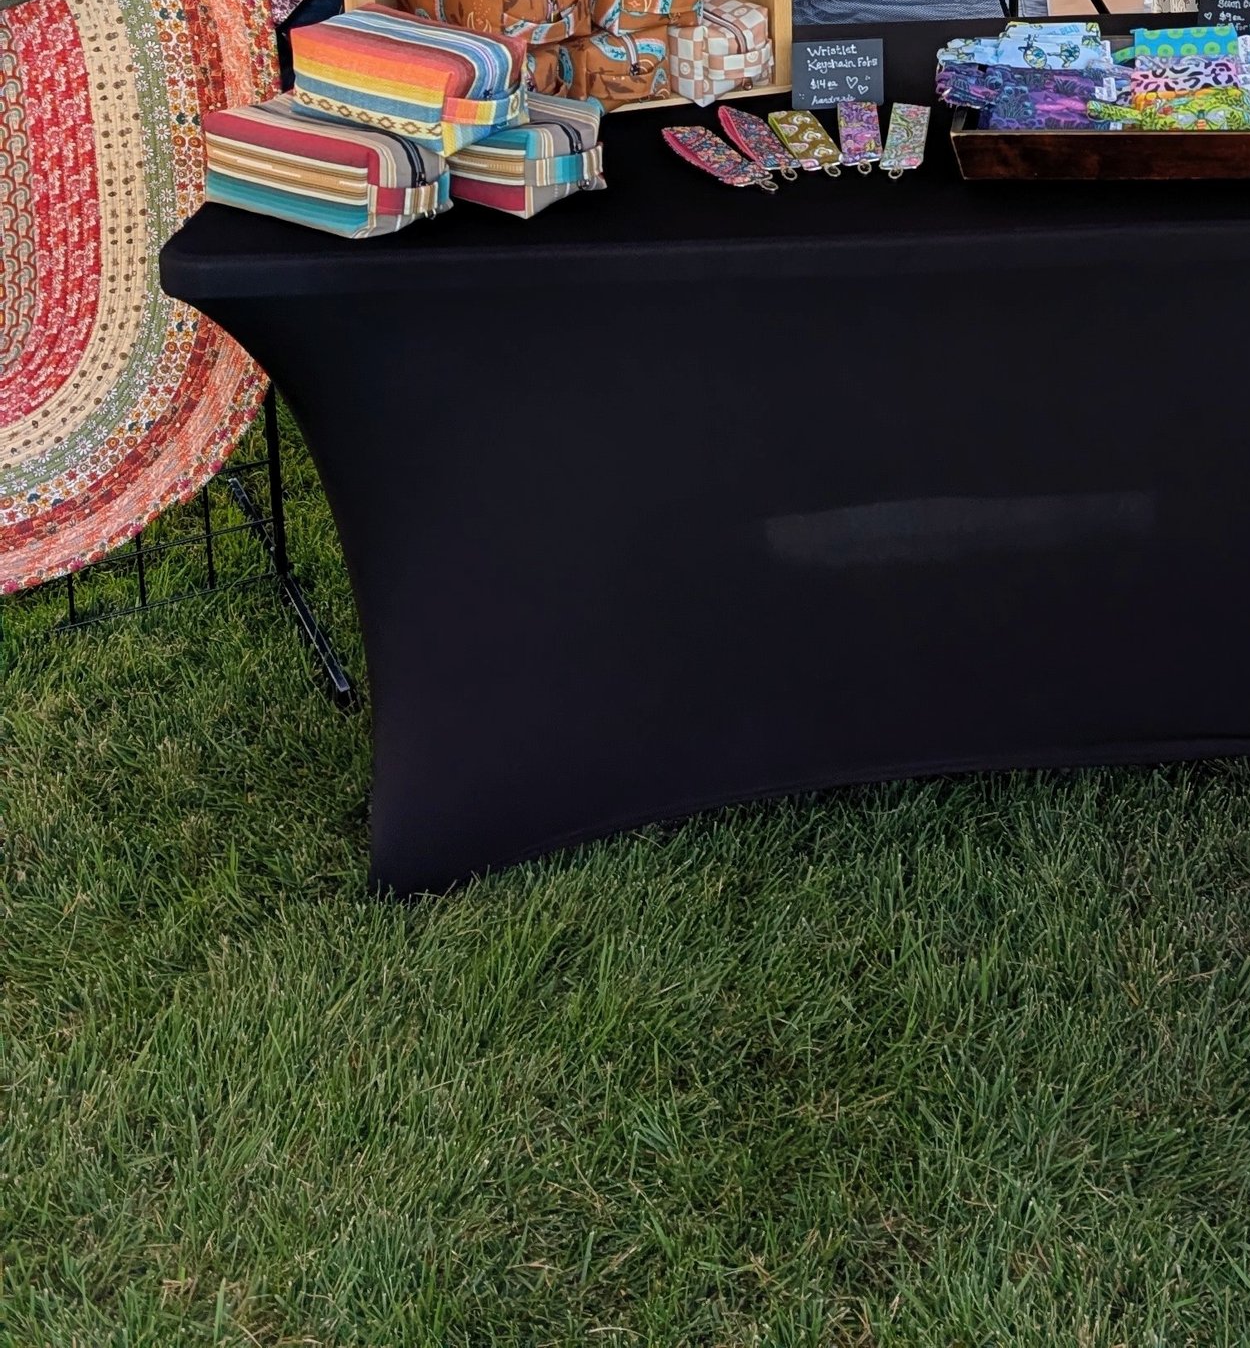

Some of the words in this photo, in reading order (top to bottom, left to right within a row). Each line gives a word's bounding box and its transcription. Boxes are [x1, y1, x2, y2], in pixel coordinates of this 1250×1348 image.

[807, 44, 857, 57] Wristlet
[807, 59, 856, 74] Keychain
[858, 56, 878, 67] Fobs
